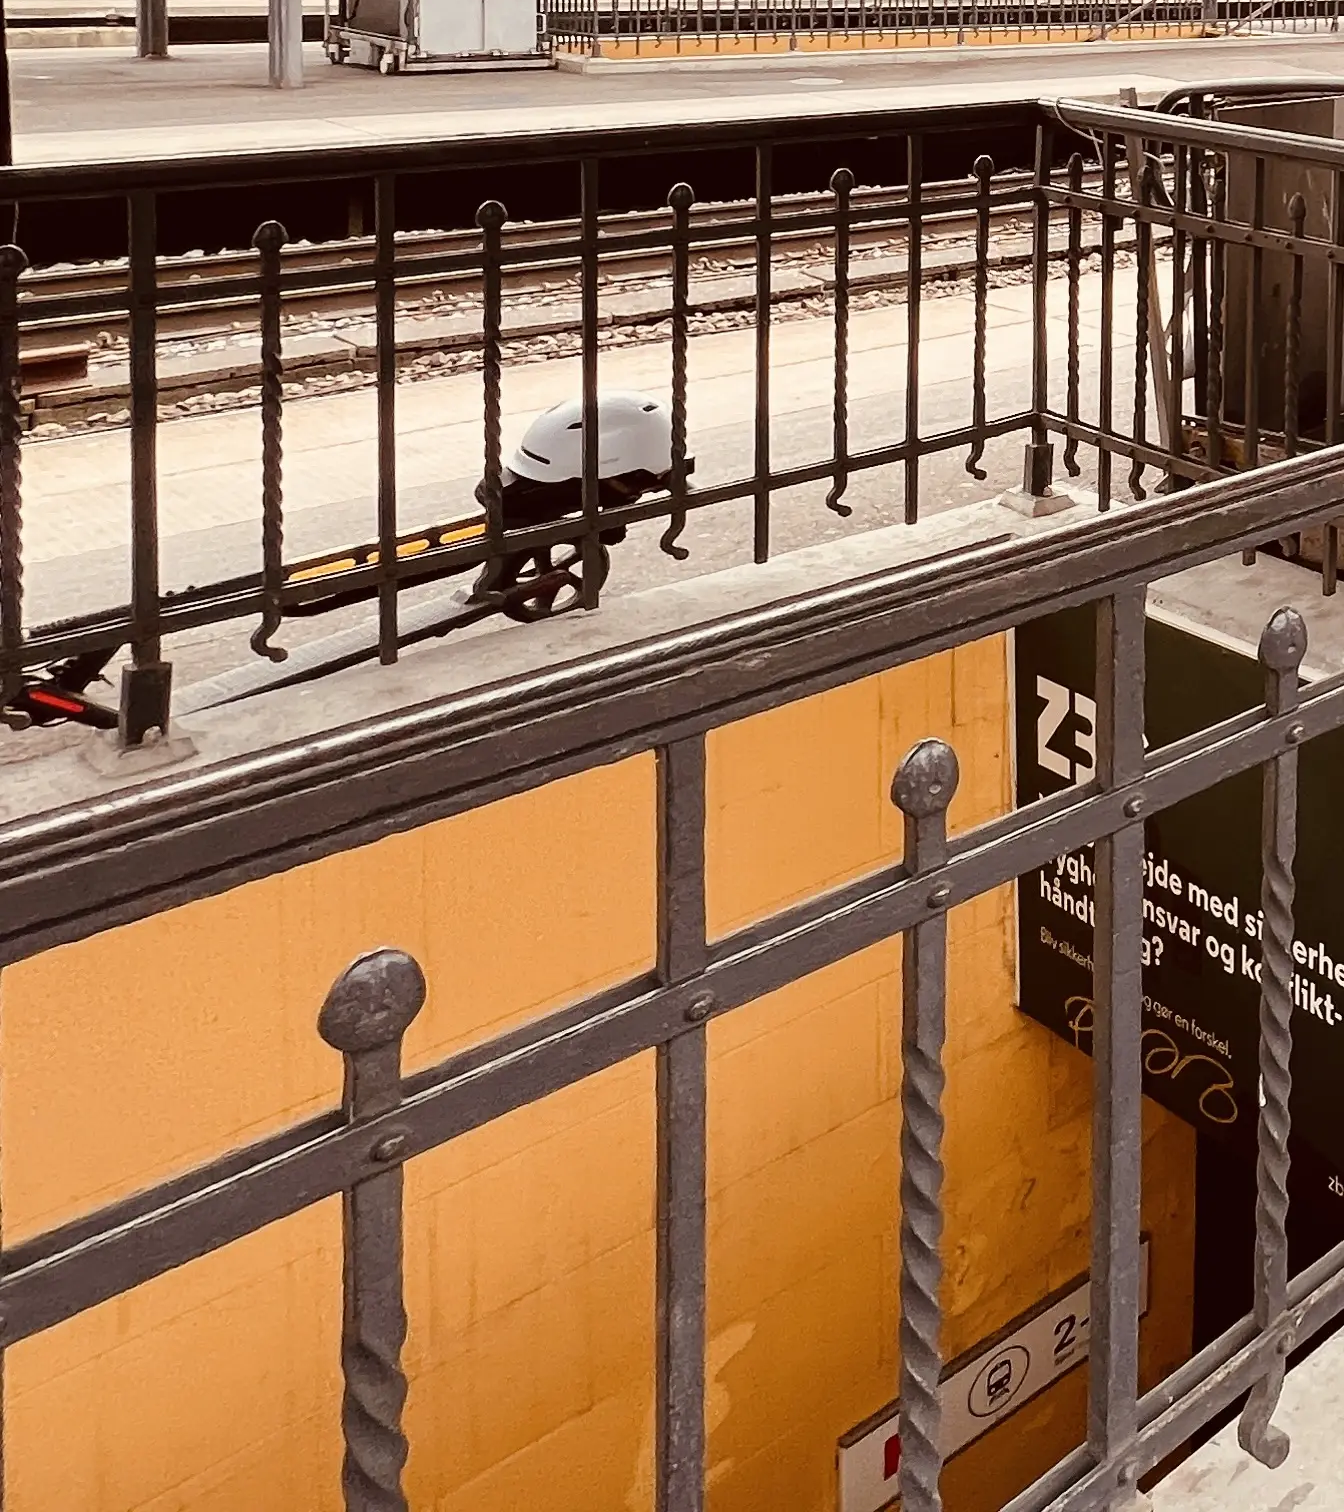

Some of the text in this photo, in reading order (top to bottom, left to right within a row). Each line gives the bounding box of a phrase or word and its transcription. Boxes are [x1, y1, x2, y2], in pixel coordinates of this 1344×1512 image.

[1188, 882, 1239, 928] med
[1142, 898, 1201, 947] nsvar
[1205, 936, 1235, 975] og
